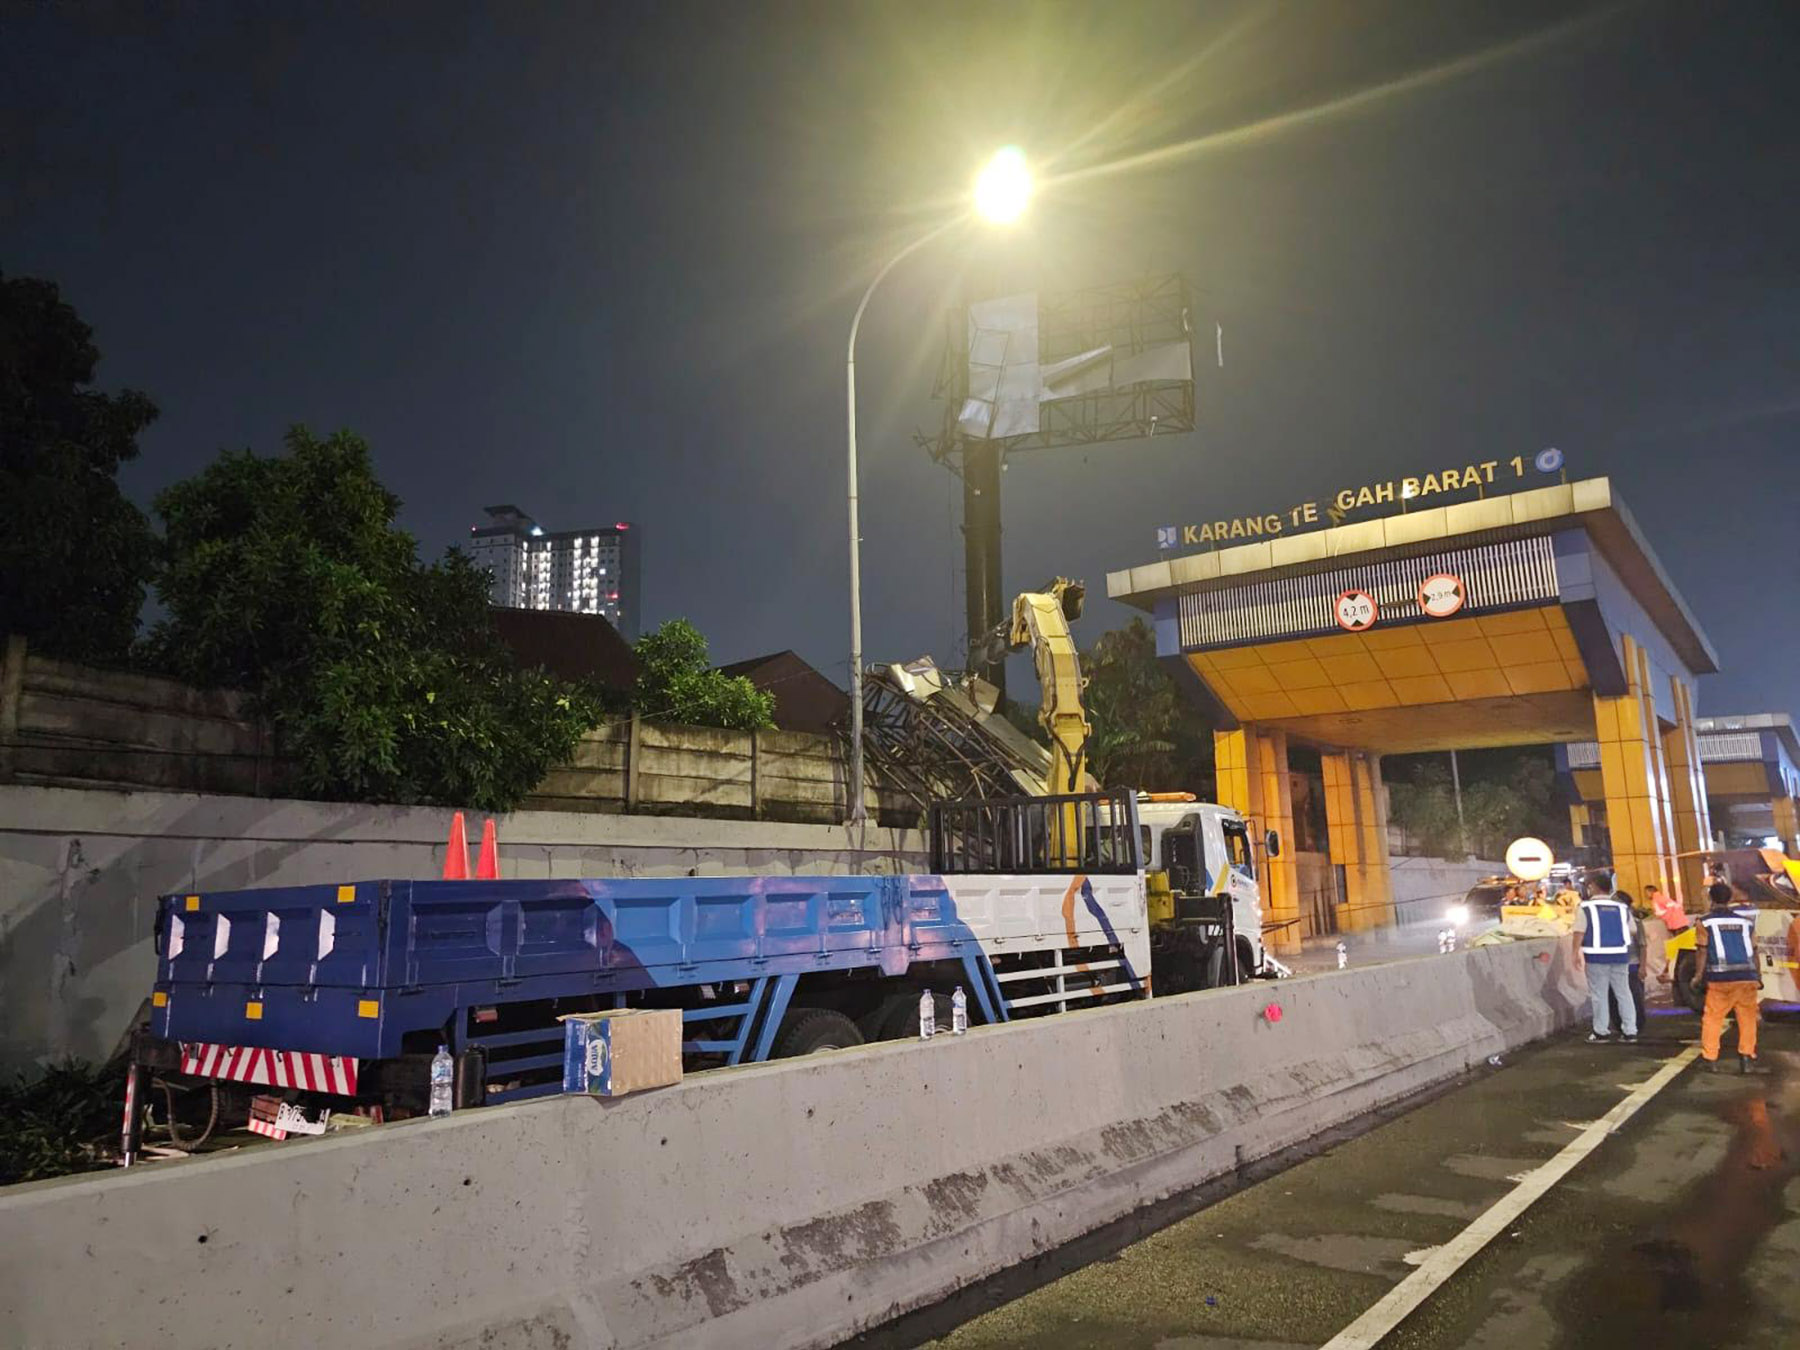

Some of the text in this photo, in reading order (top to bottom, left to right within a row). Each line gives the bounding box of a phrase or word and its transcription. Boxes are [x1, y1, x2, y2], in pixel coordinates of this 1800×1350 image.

[1183, 514, 1282, 544] KARANG
[1402, 460, 1498, 499] BARAT
[1511, 456, 1523, 477] 1
[591, 1044, 599, 1071] AQUA
